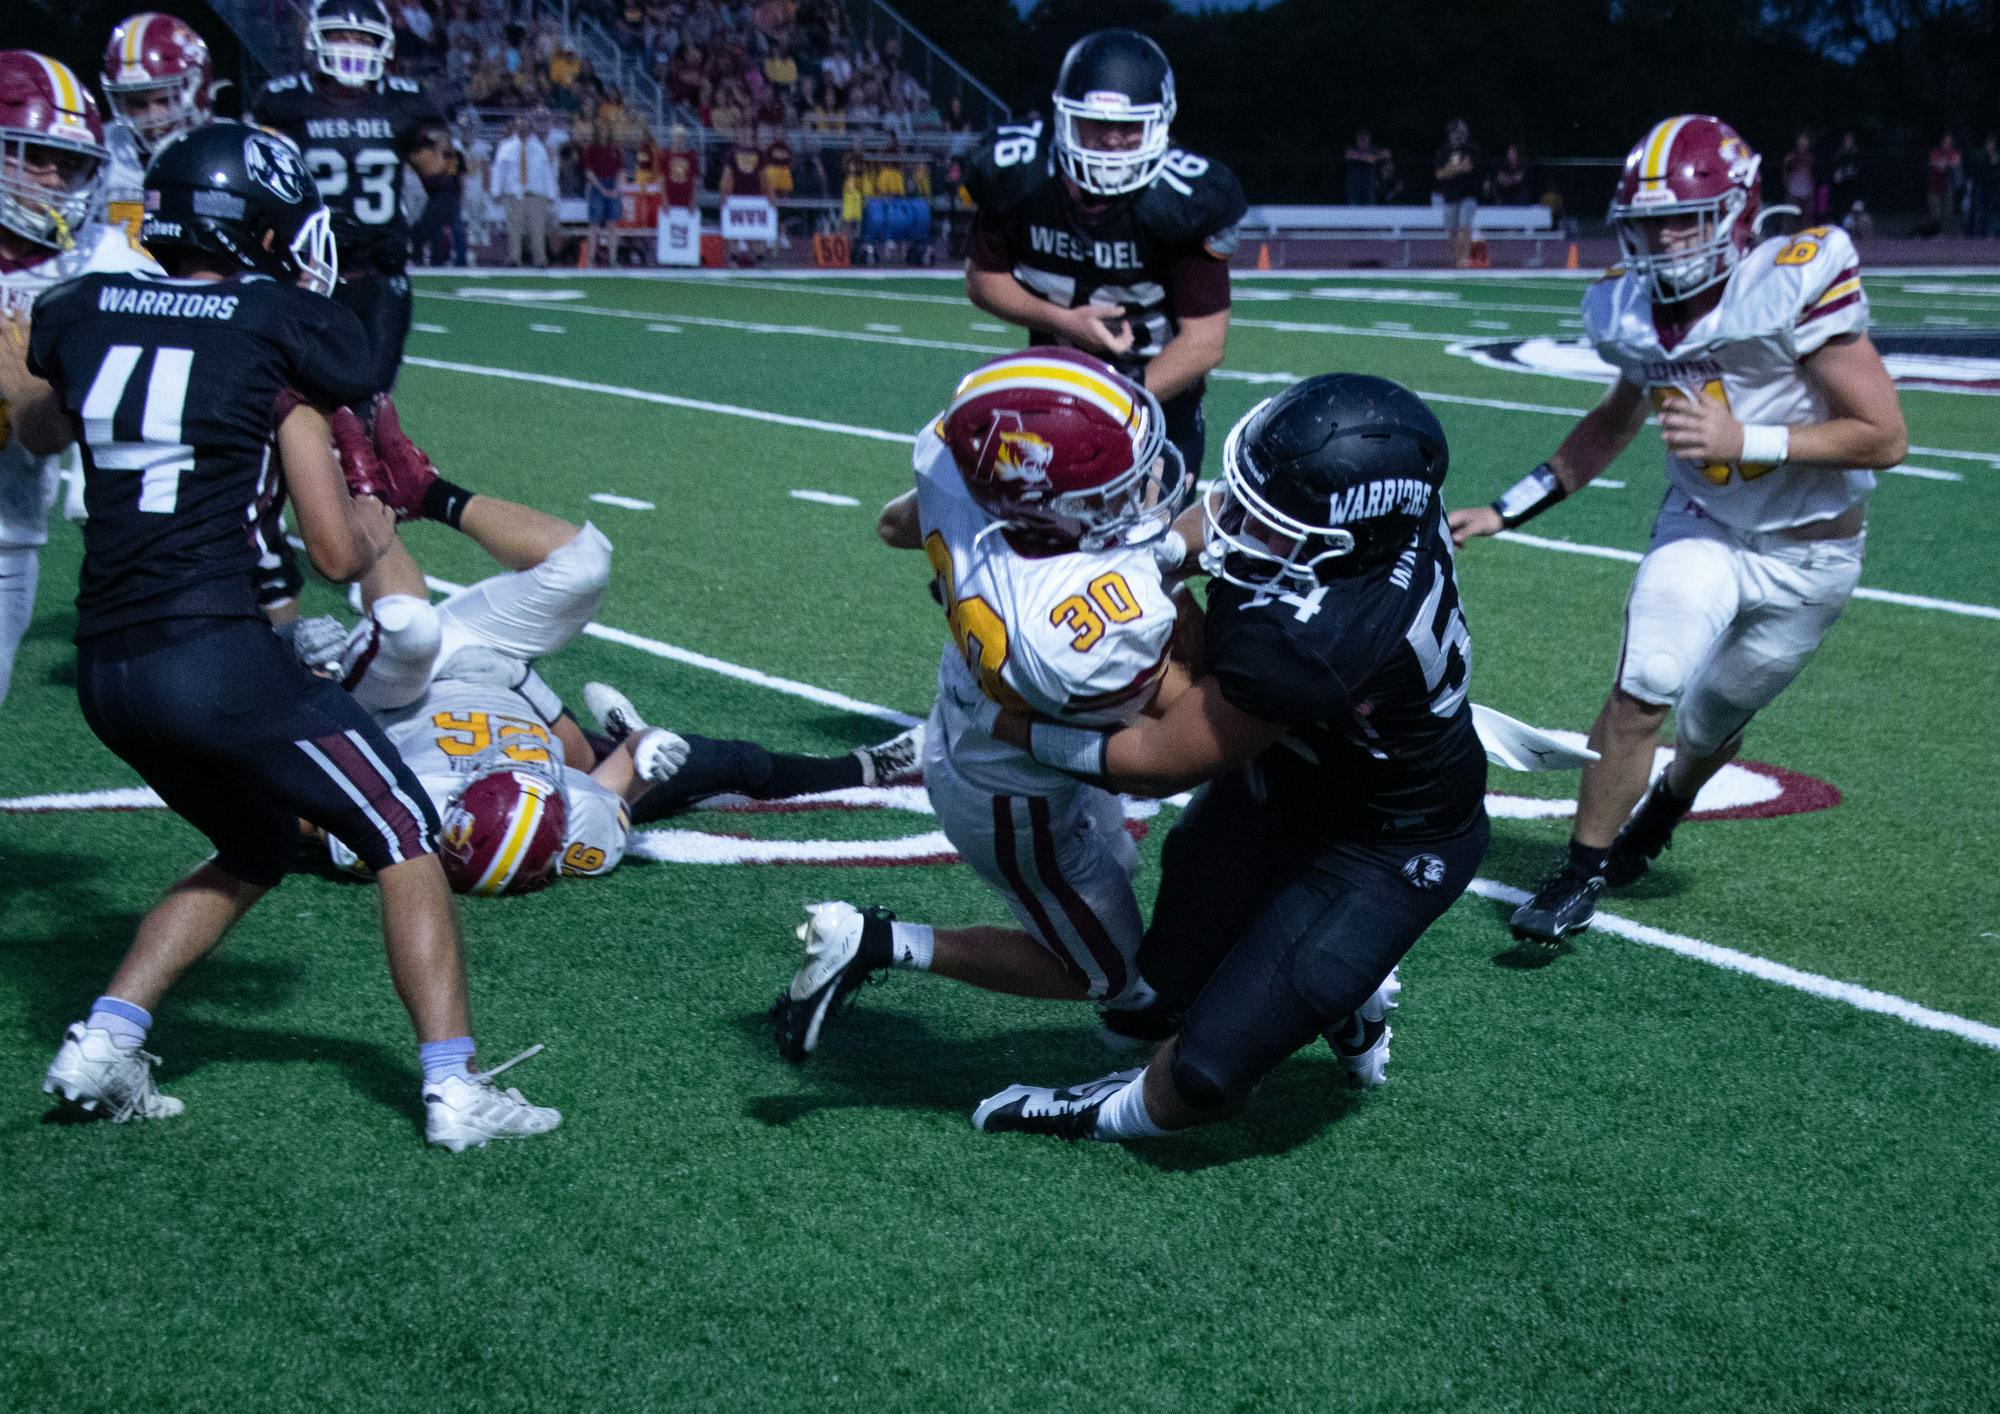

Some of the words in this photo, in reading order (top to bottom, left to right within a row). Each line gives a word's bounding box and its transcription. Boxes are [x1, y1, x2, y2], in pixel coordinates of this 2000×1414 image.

[305, 118, 395, 139] WES-DEL
[994, 120, 1043, 168] 76
[303, 147, 400, 225] 23
[821, 236, 847, 258] 50
[1030, 224, 1145, 269] WES-DEL
[98, 286, 240, 321] WARRIORS
[82, 344, 196, 515] 4
[1328, 478, 1433, 527] WARRIORS
[1049, 571, 1143, 653] 30
